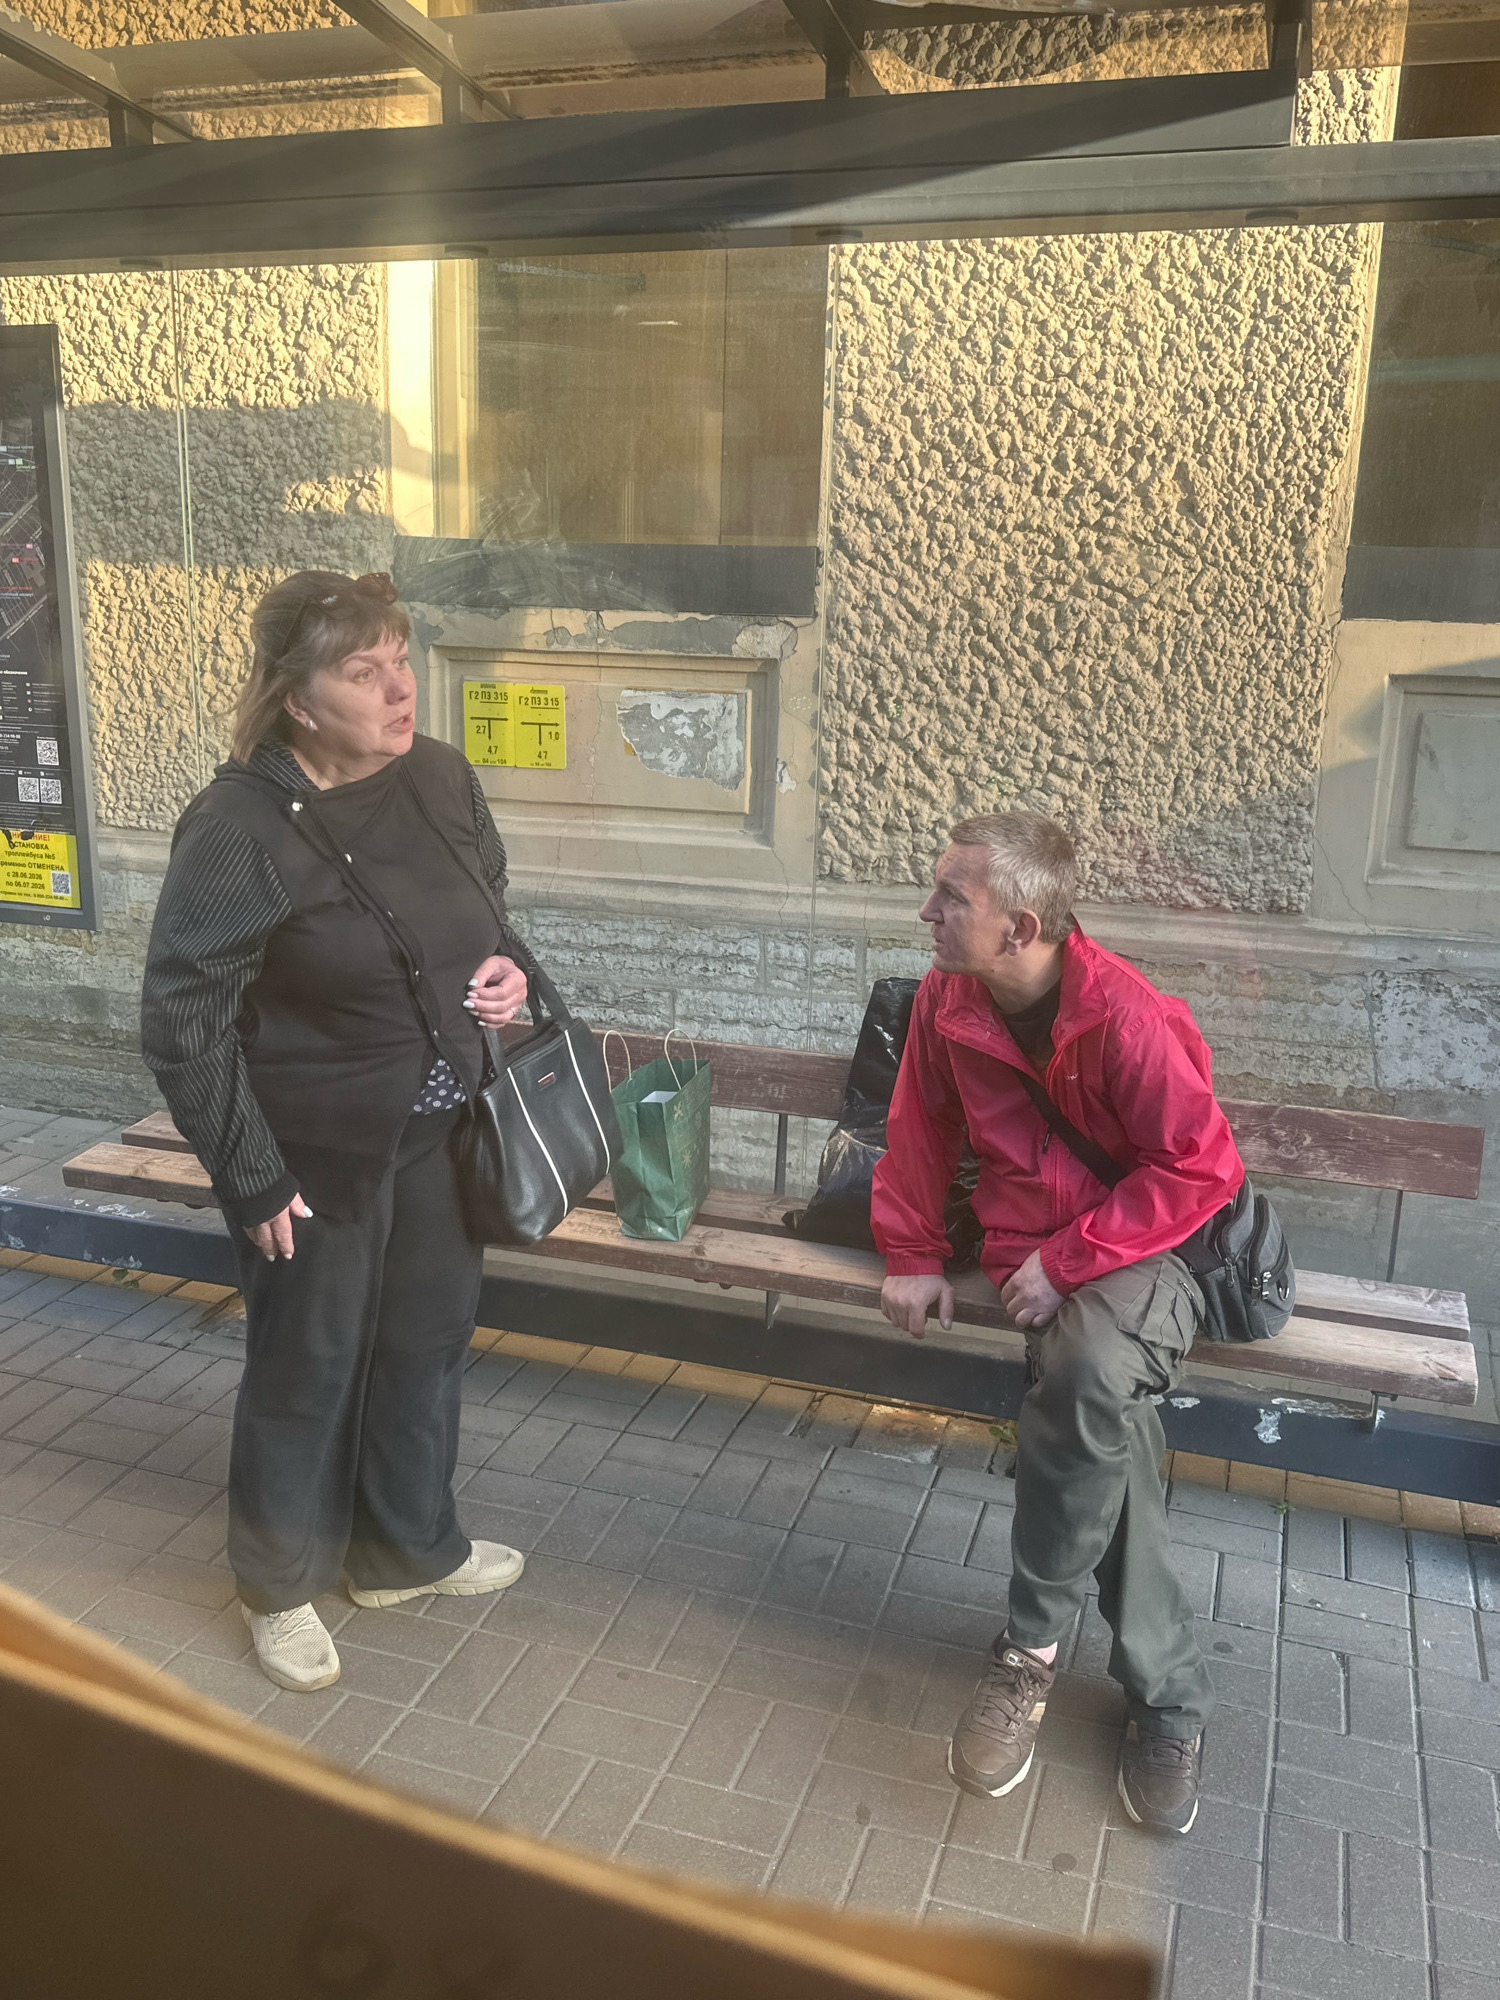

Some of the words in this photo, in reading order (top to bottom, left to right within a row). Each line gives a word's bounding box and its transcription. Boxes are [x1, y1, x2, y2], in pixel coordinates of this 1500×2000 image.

[469, 691, 479, 700] Г2
[494, 692, 508, 701] 315
[519, 696, 529, 705] Г2
[544, 697, 559, 706] 315
[5, 851, 43, 859] троллейбуса
[28, 862, 64, 871] ОТМЕНЕНА
